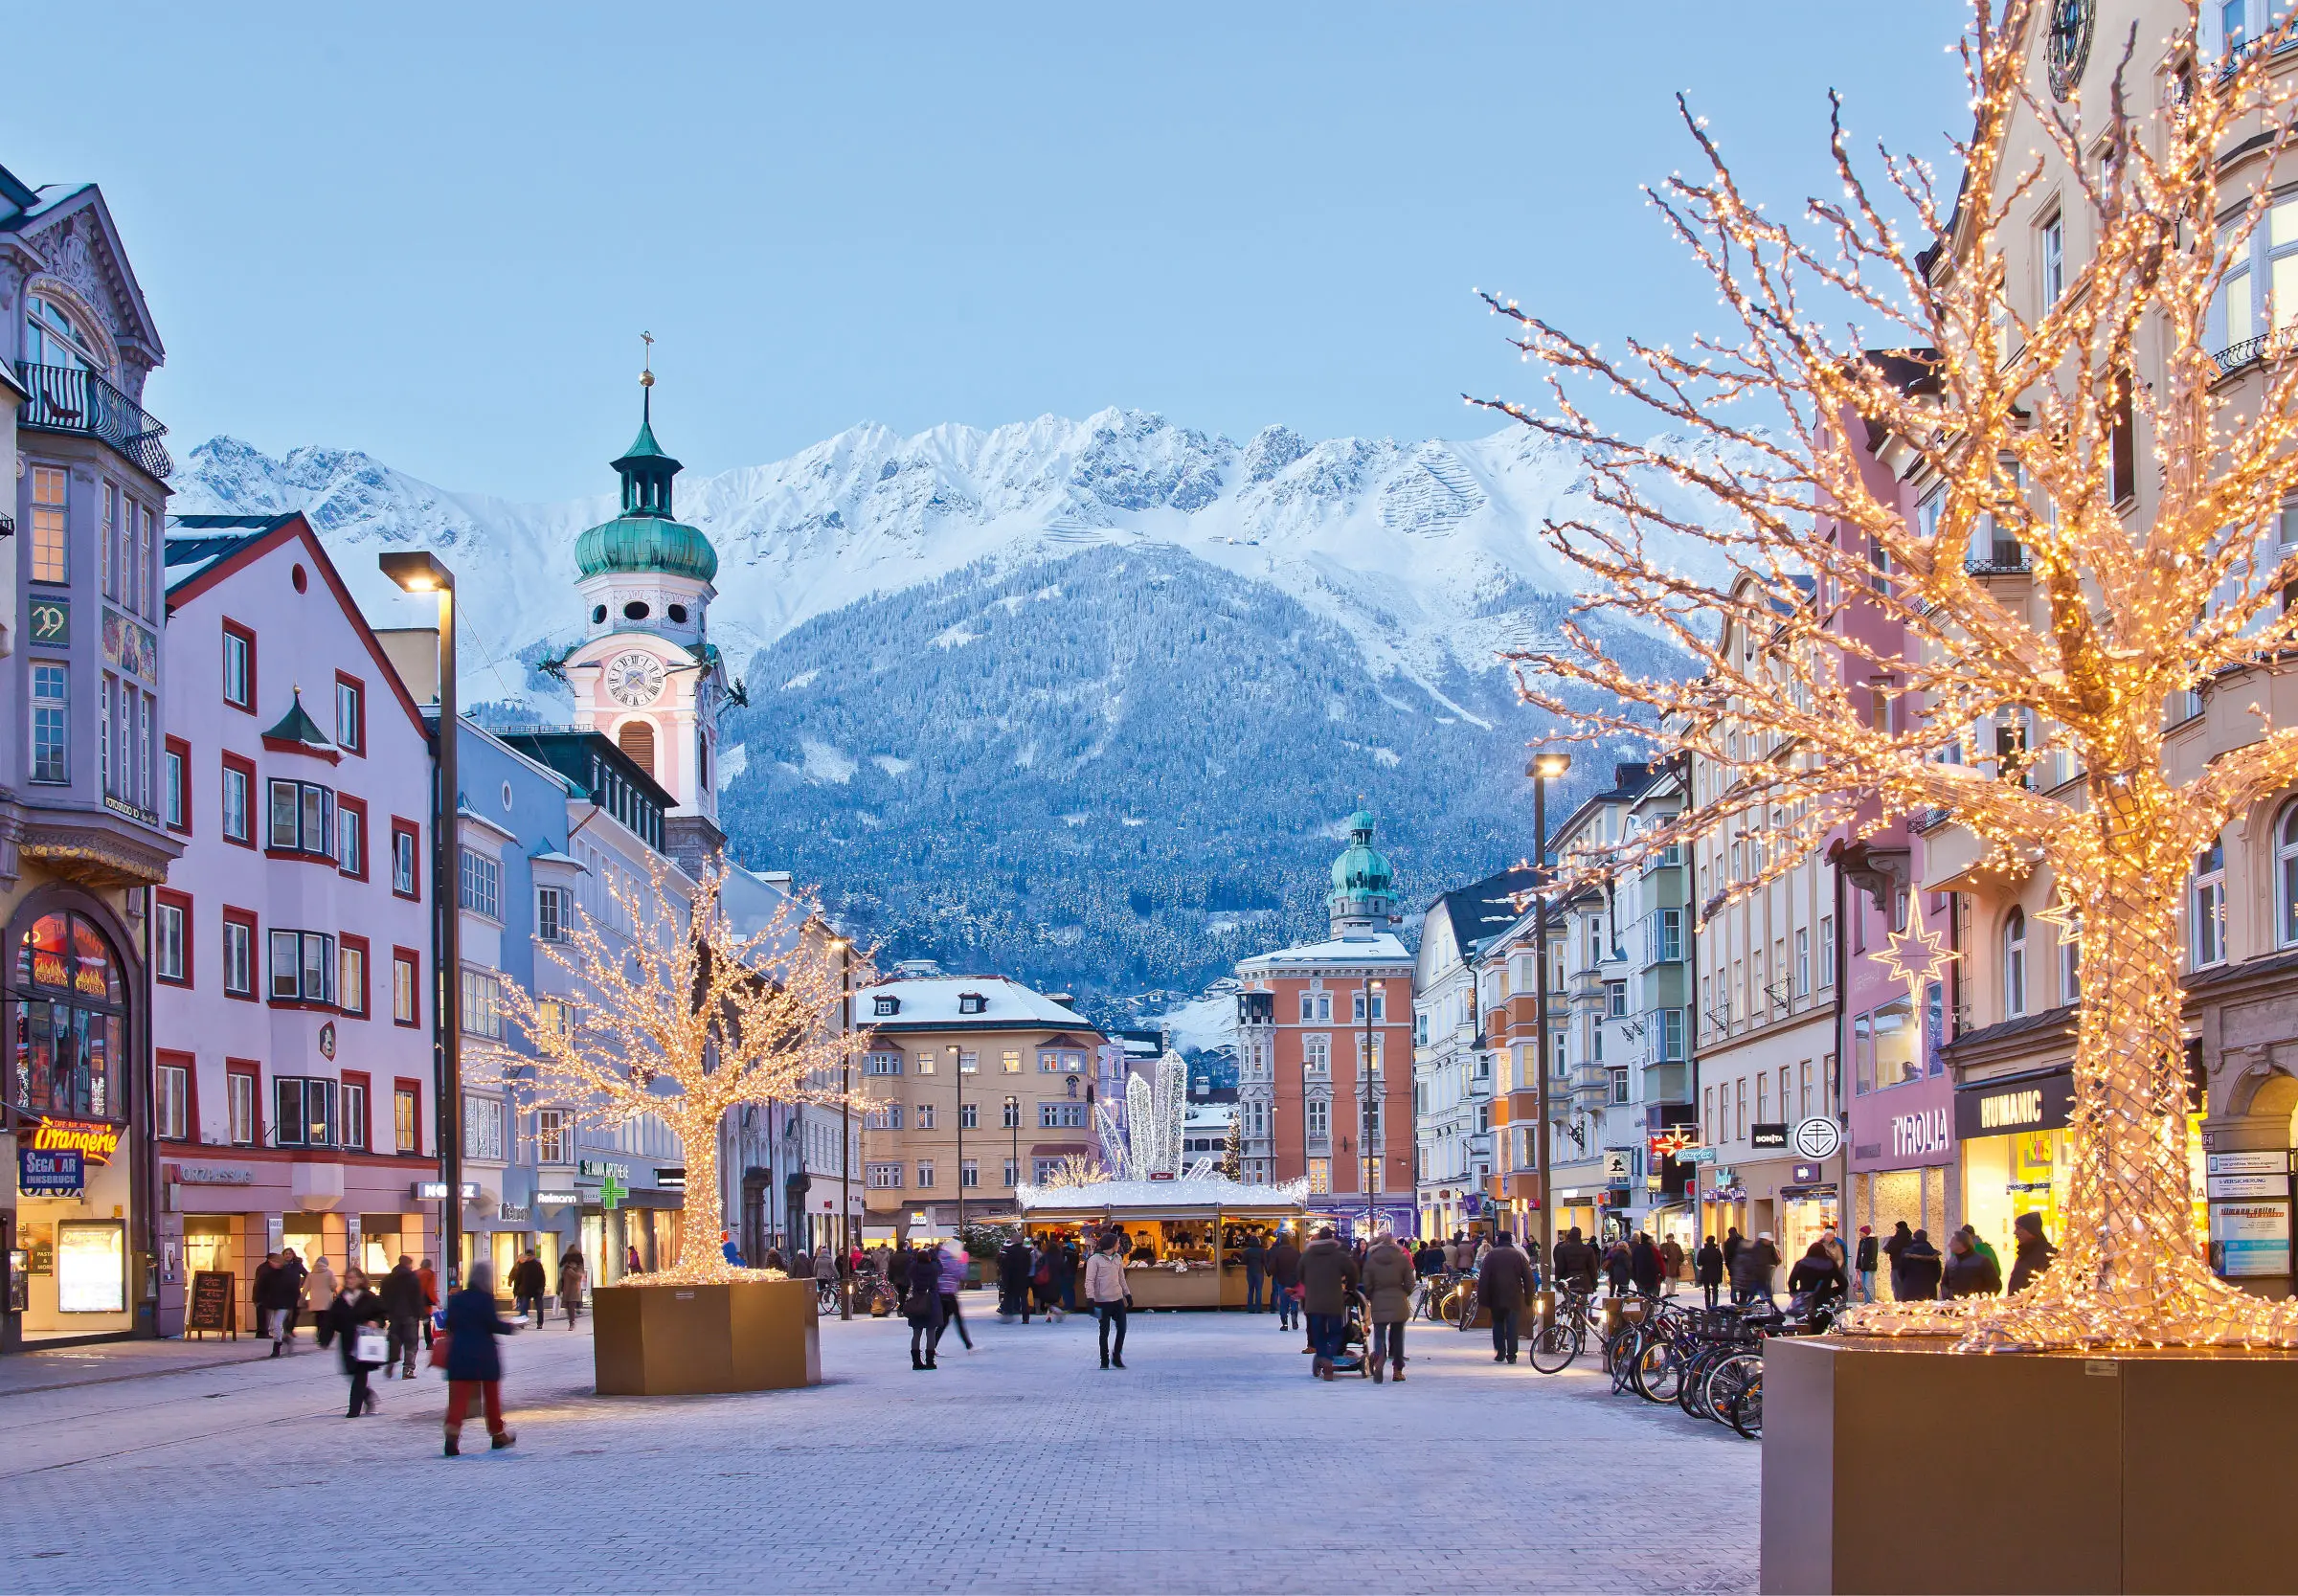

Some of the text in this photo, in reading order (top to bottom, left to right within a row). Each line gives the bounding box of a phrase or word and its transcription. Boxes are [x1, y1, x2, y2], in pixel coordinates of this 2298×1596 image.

[1980, 1090, 2042, 1129] HUMANIC
[34, 1115, 117, 1159] Orangerie
[1755, 1134, 1784, 1144] BONITA
[1891, 1107, 1949, 1157] TYROLIA
[1678, 1149, 1713, 1161] Douglas
[2028, 1139, 2053, 1161] KIDS
[424, 1184, 476, 1197] NOZ
